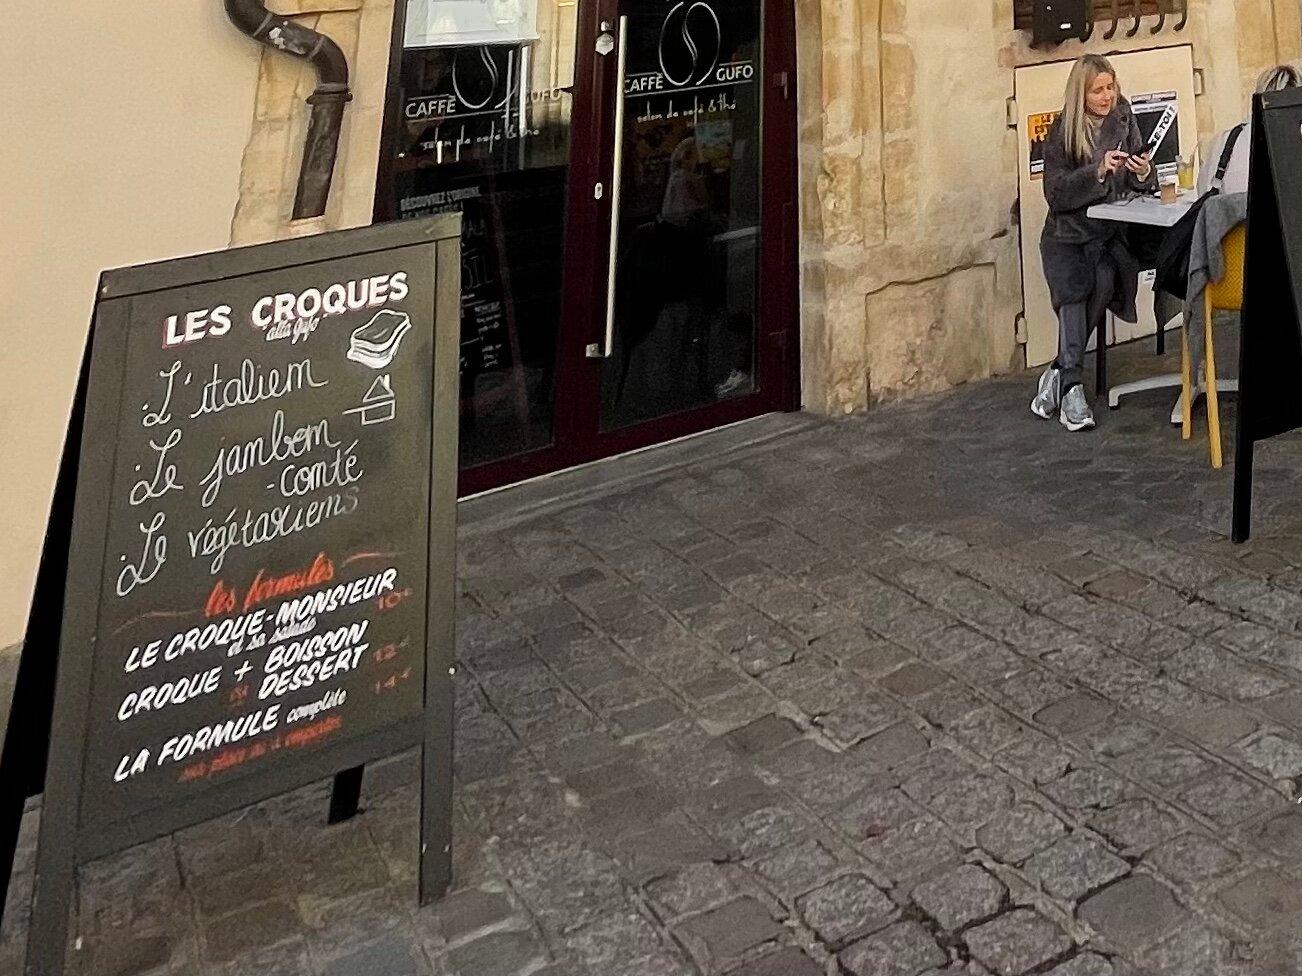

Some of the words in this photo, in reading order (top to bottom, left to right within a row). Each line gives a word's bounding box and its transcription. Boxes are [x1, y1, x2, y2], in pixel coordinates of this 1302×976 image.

[716, 65, 754, 82] GUFO
[163, 304, 233, 347] LES
[251, 271, 410, 328] CROQUES
[129, 428, 184, 506] Le
[116, 511, 167, 597] Le
[125, 640, 162, 673] LE
[164, 567, 398, 659] CROQUE-MONSIEUR
[117, 666, 223, 722] CROQUE
[264, 619, 369, 674] BOISSON
[257, 644, 369, 700] DESSERT
[114, 747, 151, 783] LA
[156, 704, 282, 766] FORMULE
